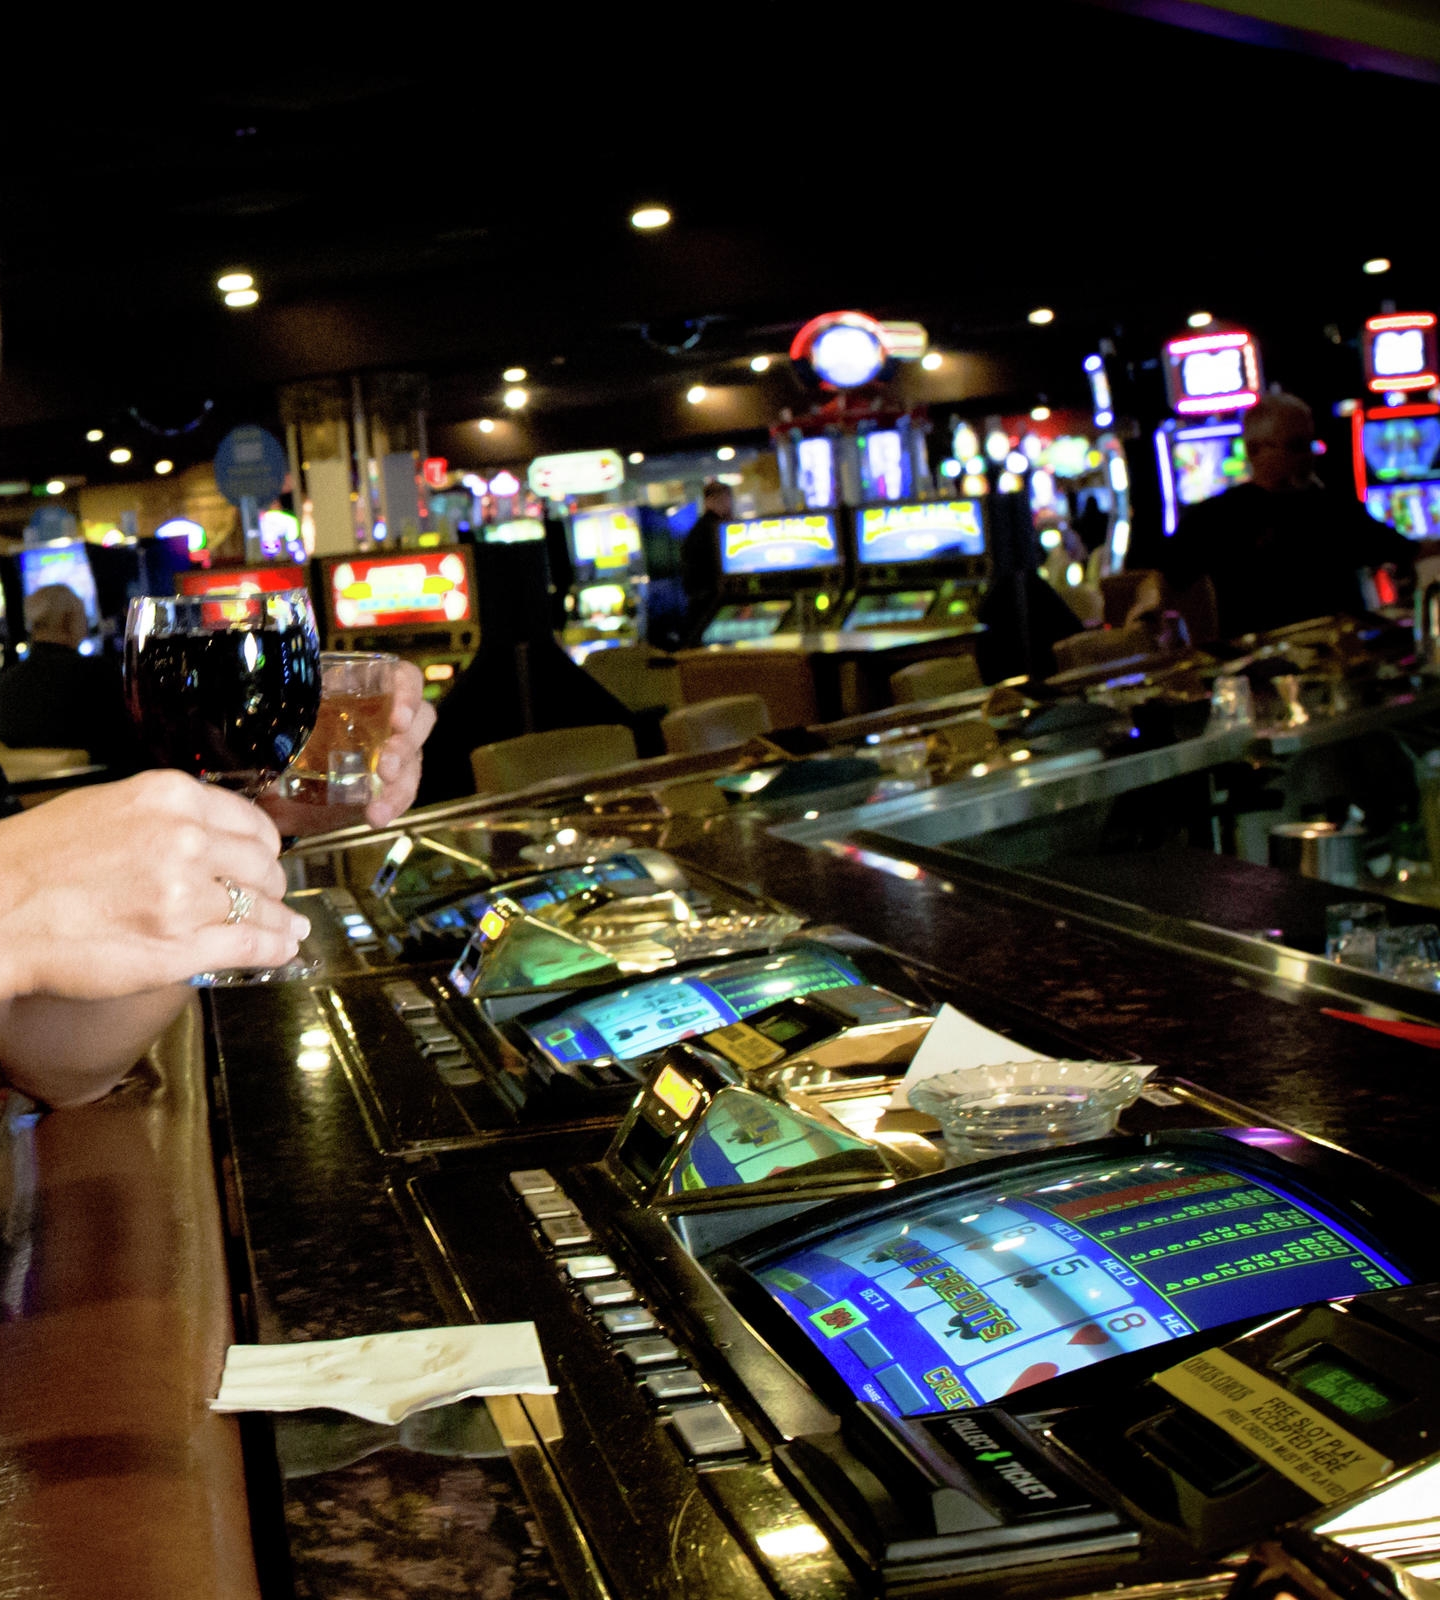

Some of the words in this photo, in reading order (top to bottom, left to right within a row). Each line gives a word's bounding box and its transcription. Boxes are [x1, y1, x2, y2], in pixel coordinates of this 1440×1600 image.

[1050, 1222, 1083, 1242] HELD
[1199, 1231, 1220, 1242] 12
[1234, 1259, 1256, 1271] 16
[1215, 1227, 1238, 1238] 39
[1251, 1254, 1275, 1268] 52
[1236, 1224, 1256, 1234] 48
[1270, 1250, 1294, 1263] 64
[1253, 1220, 1275, 1230] 75
[1284, 1242, 1312, 1259] 100
[1263, 1213, 1292, 1227] 600
[1299, 1238, 1330, 1256] 800
[1281, 1209, 1310, 1225] 750
[1311, 1230, 1350, 1254] 1000
[1051, 1258, 1090, 1276] 5
[1099, 1258, 1140, 1286] HELD
[1100, 1230, 1115, 1238] 2
[1166, 1283, 1181, 1291] 4
[1119, 1226, 1133, 1234] 4
[1183, 1277, 1199, 1286] 8
[1216, 1263, 1237, 1276] 12
[1202, 1273, 1218, 1281] 8
[859, 1288, 885, 1304] BET
[876, 1303, 890, 1311] 1
[922, 1266, 1018, 1342] CREDITS
[1107, 1313, 1146, 1333] 8
[1247, 1406, 1313, 1450] ACCEPTED
[1305, 1446, 1349, 1475] HERE
[1263, 1397, 1302, 1420] FREE
[1293, 1417, 1333, 1441] SLOT
[1324, 1439, 1366, 1465] PLAY
[947, 1417, 1000, 1450] COLLECT
[994, 1461, 1057, 1500] TICKET
[1272, 1445, 1302, 1464] MUST
[1294, 1462, 1315, 1474] BE
